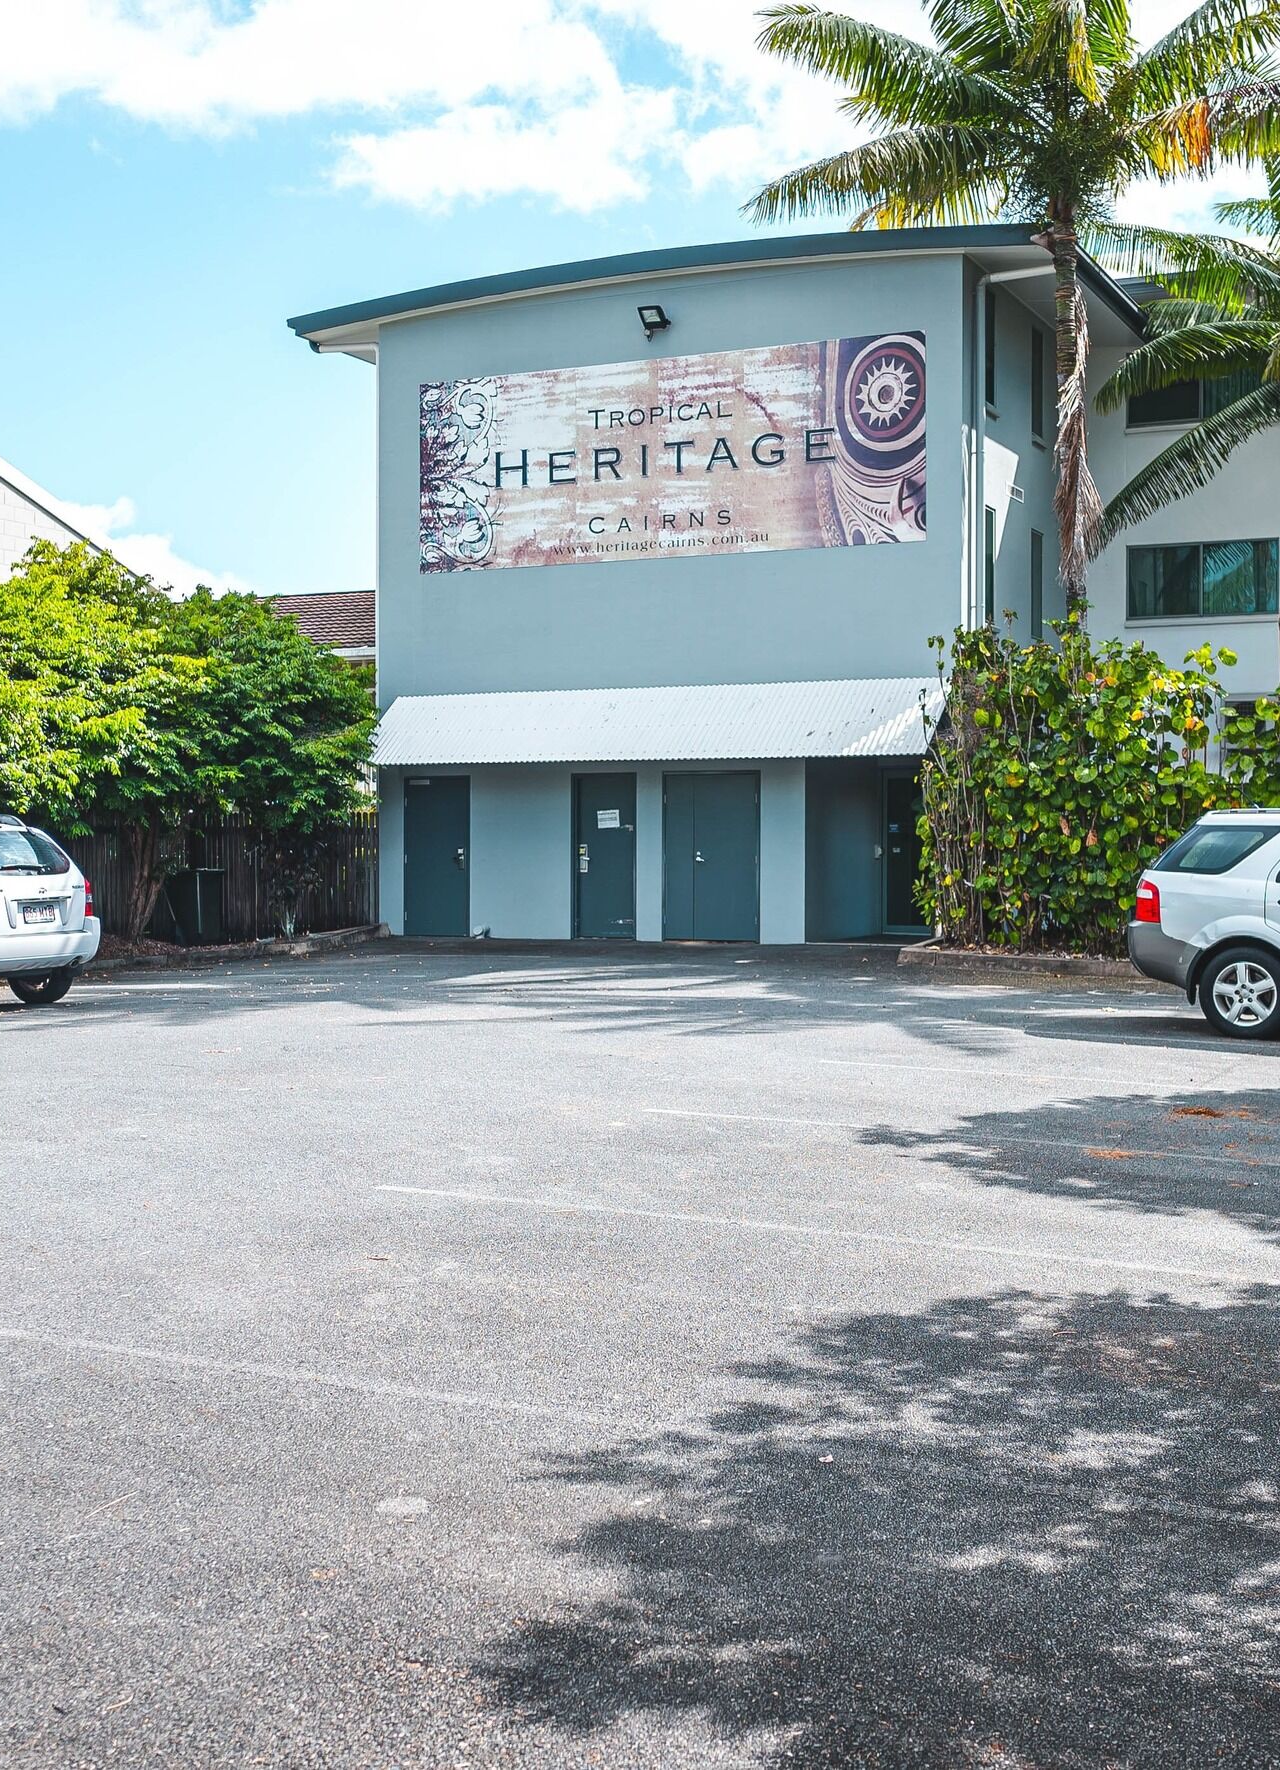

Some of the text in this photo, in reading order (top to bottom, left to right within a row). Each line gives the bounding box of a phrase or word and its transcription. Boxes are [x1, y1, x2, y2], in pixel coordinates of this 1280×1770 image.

[588, 401, 733, 429] TROPICAL
[495, 427, 836, 489] HERITAGE
[588, 510, 732, 534] CAIRNS
[552, 532, 769, 555] www.heritagecairns.com.au
